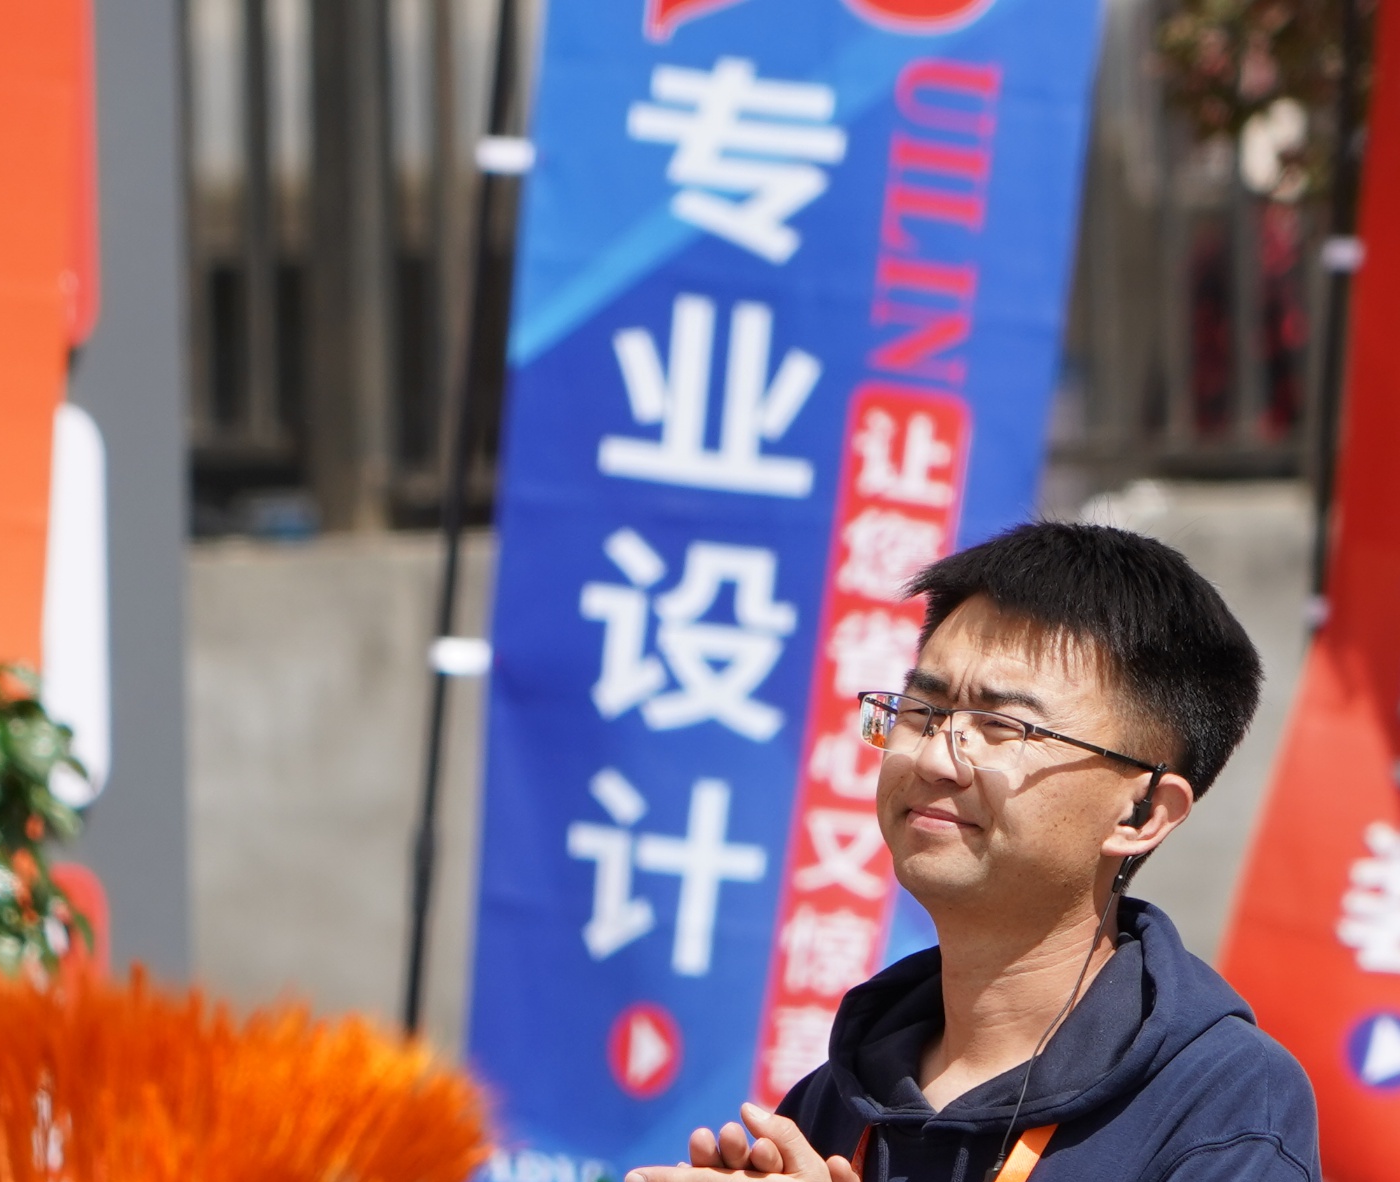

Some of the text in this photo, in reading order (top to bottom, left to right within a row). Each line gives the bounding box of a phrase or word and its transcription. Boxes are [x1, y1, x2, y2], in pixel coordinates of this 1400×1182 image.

[566, 55, 848, 978] 专业设计
[866, 56, 1002, 390] UILIN
